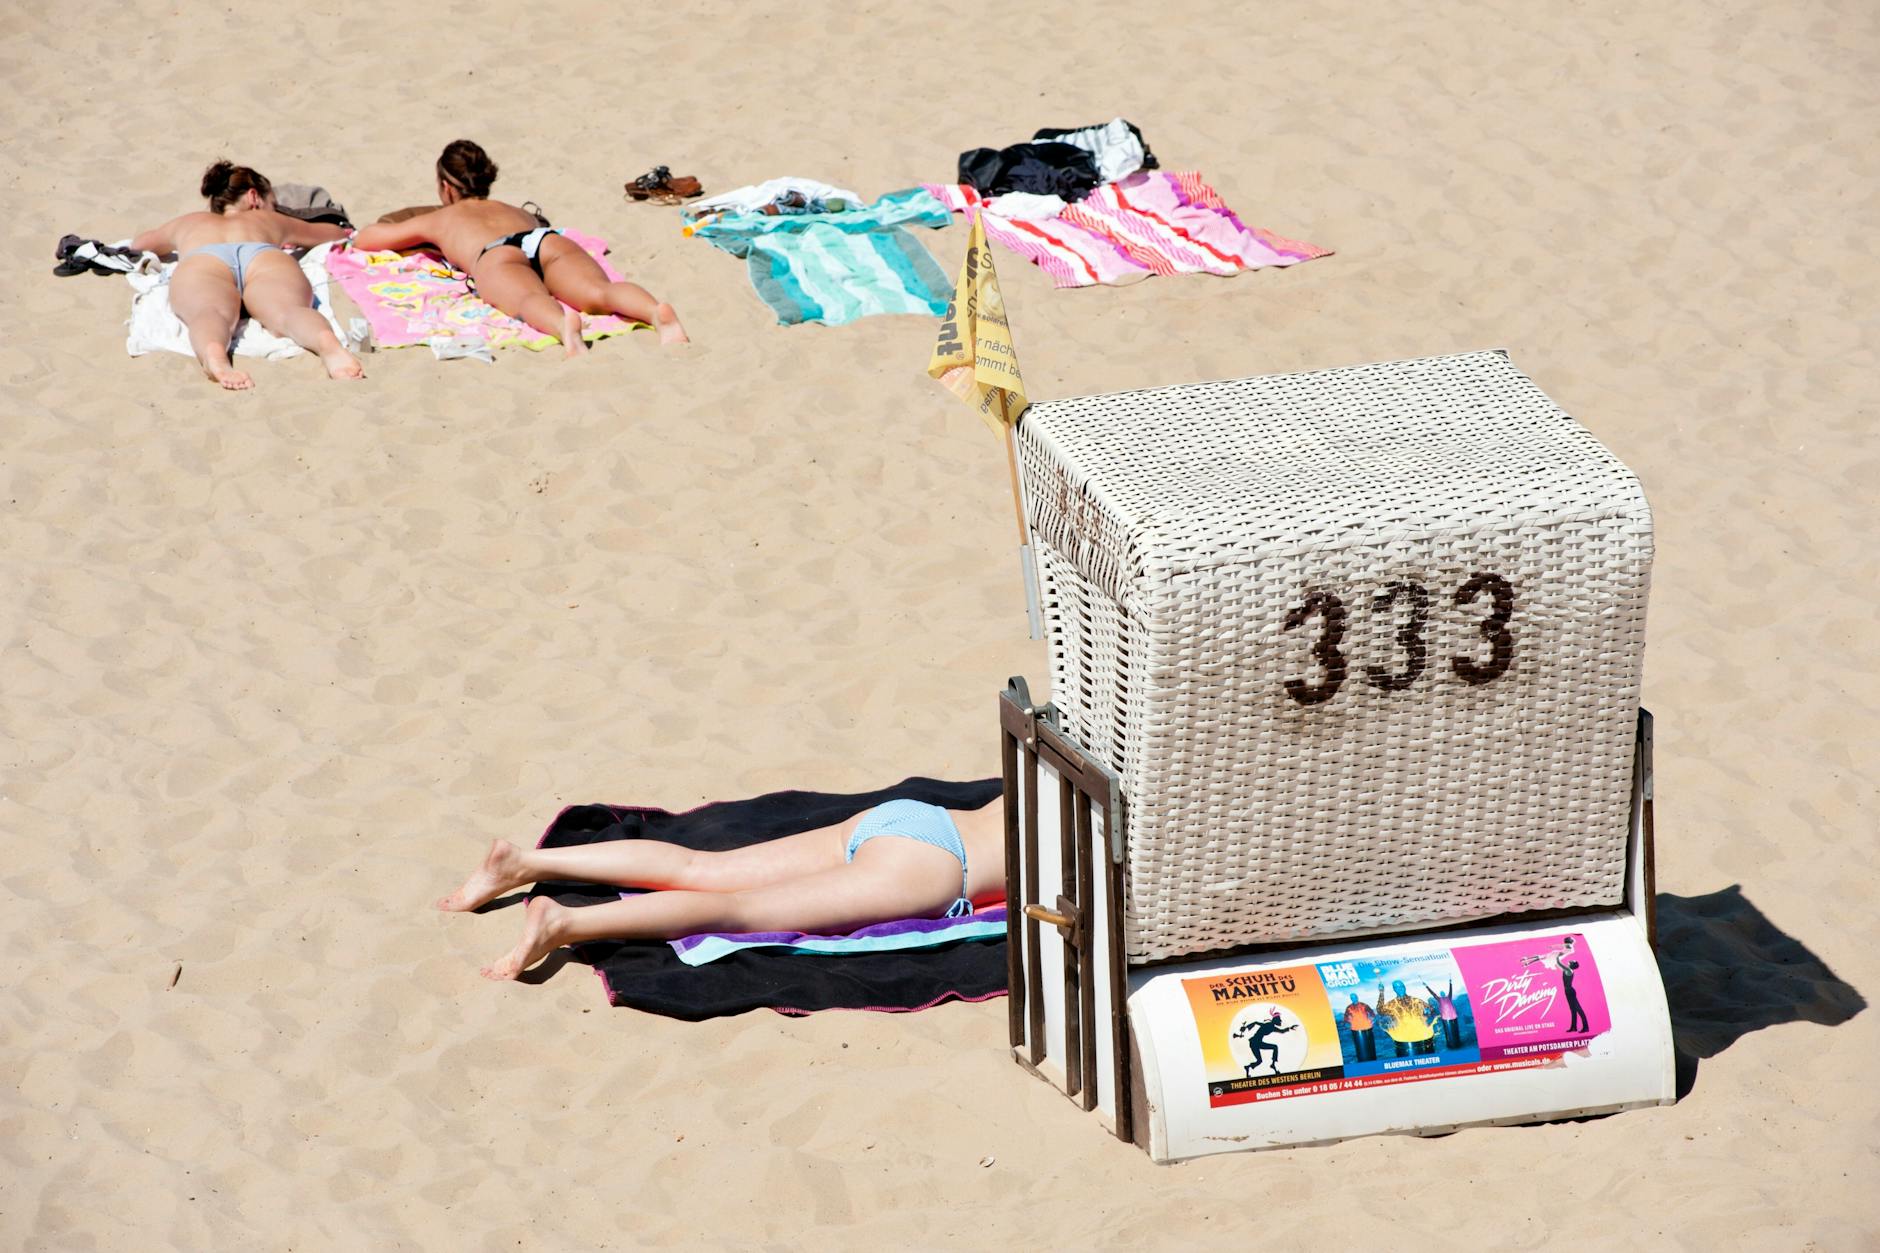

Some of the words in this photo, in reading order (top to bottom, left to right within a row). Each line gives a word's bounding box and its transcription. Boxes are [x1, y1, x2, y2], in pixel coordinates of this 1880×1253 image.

[976, 356, 1007, 372] ommt
[1284, 572, 1515, 706] 333
[1225, 973, 1277, 987] SCHUH
[1324, 969, 1359, 981] MAN
[1327, 977, 1360, 988] GROUP
[1211, 979, 1296, 1001] MANITU
[1480, 970, 1544, 1006] Dirty
[1495, 981, 1557, 1023] Dancing
[1503, 1045, 1529, 1055] THEATER
[1528, 1045, 1538, 1053] AM
[1538, 1041, 1573, 1052] POTSDAMER
[1383, 1059, 1413, 1069] BLUEMAX
[1413, 1056, 1440, 1066] THEATER
[1230, 1080, 1258, 1089] THEATER
[1258, 1078, 1271, 1086] DES
[1271, 1074, 1299, 1084] WESTENS
[1299, 1071, 1322, 1081] BERLIN
[1256, 1091, 1281, 1100] Buchen
[1282, 1088, 1293, 1097] Sie
[1293, 1087, 1312, 1095] unter
[1477, 1062, 1492, 1072] oder
